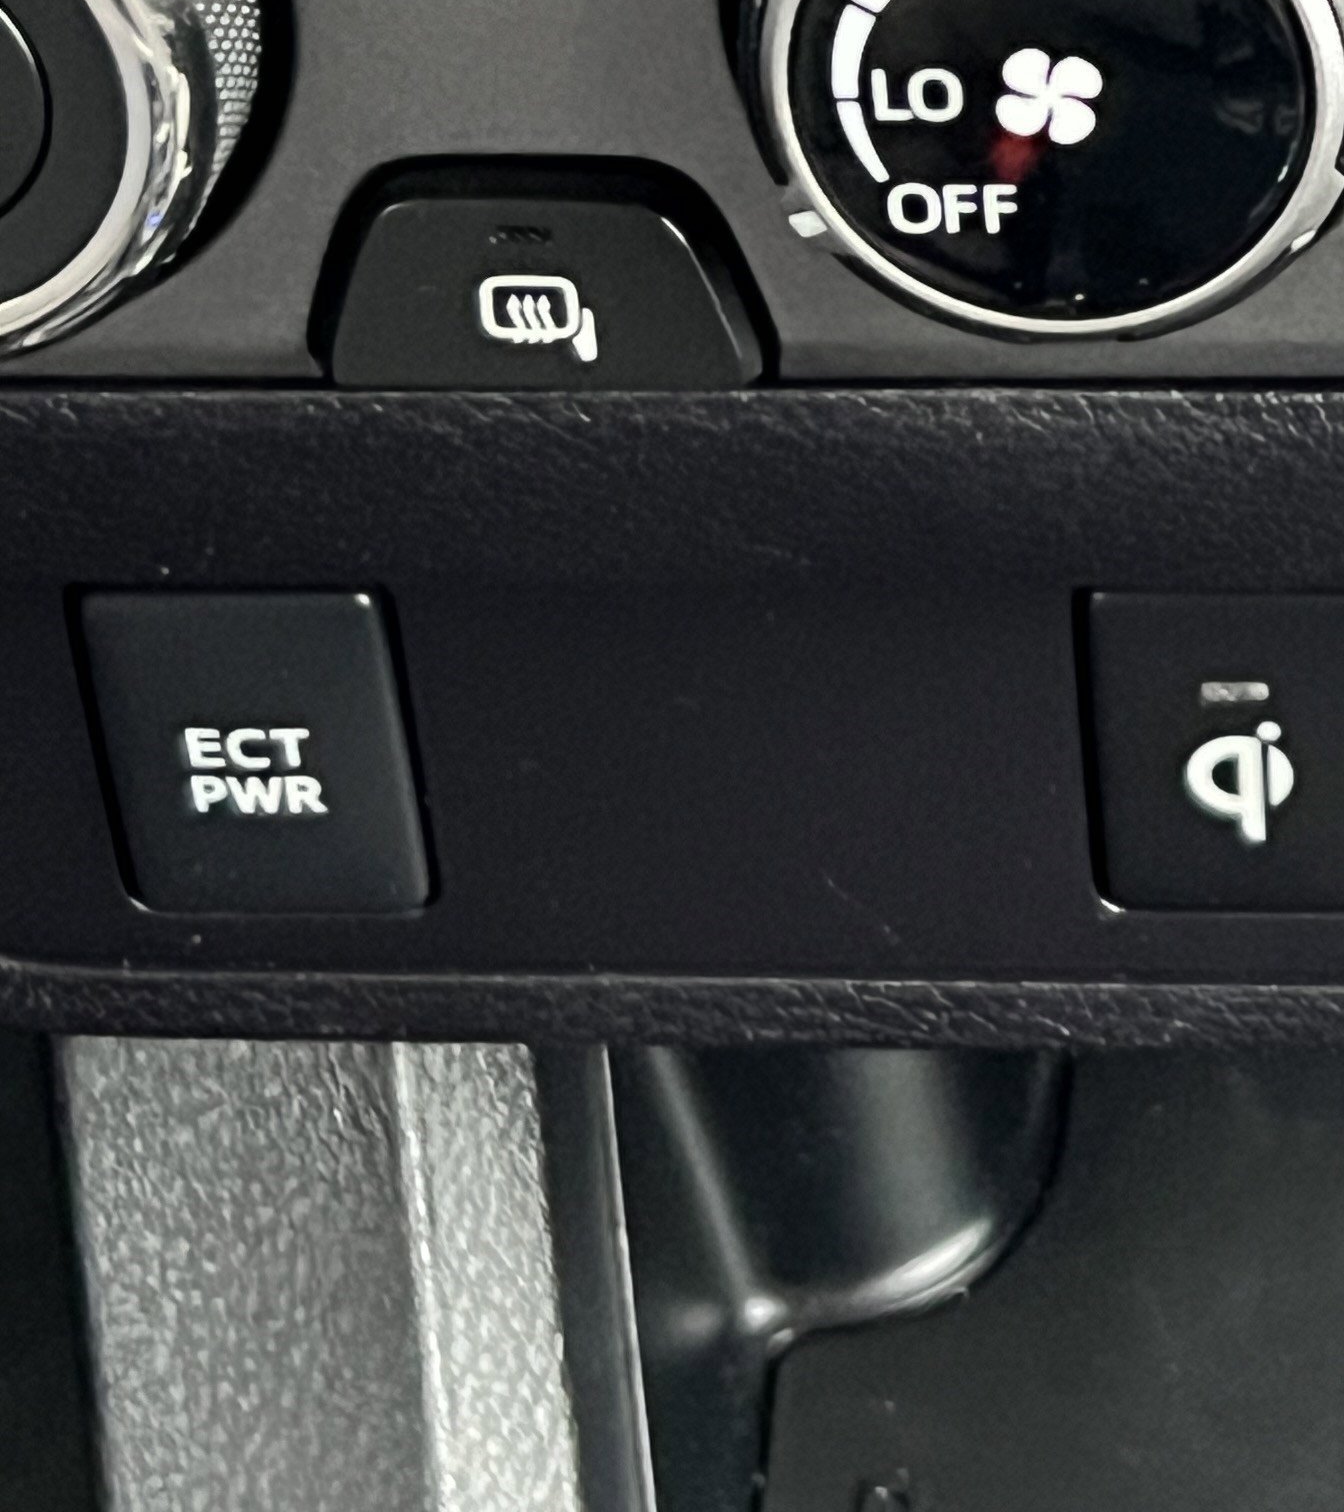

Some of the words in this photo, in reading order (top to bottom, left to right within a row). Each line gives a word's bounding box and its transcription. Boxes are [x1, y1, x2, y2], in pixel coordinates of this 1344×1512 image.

[870, 68, 964, 123] LO
[886, 182, 1019, 235] OFF
[183, 727, 310, 769] ECT
[189, 774, 329, 816] PWR
